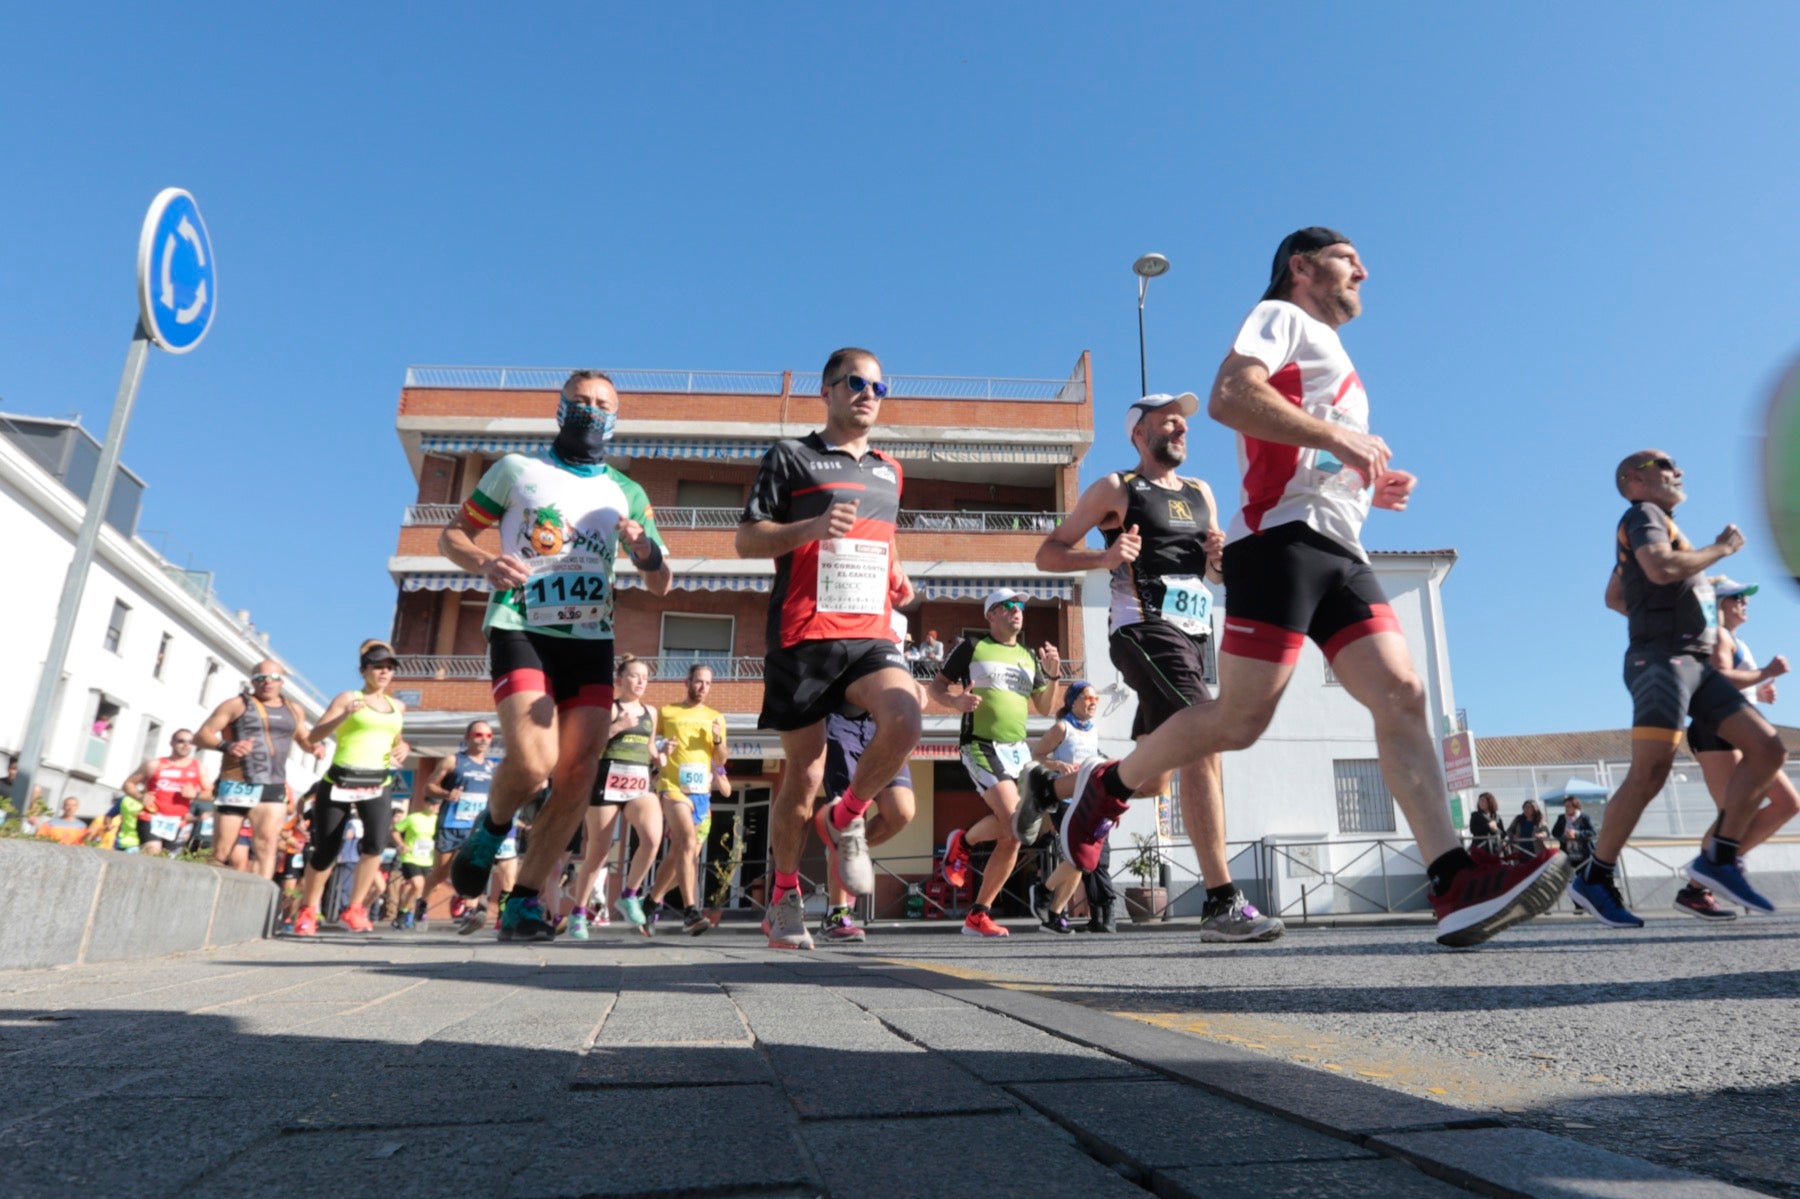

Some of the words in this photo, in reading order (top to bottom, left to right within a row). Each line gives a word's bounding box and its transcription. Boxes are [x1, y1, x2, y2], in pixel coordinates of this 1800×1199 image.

[532, 576, 604, 602] 1142
[1175, 589, 1207, 618] 813
[731, 743, 762, 755] ADA
[225, 782, 254, 795] 759
[609, 775, 647, 790] 2220
